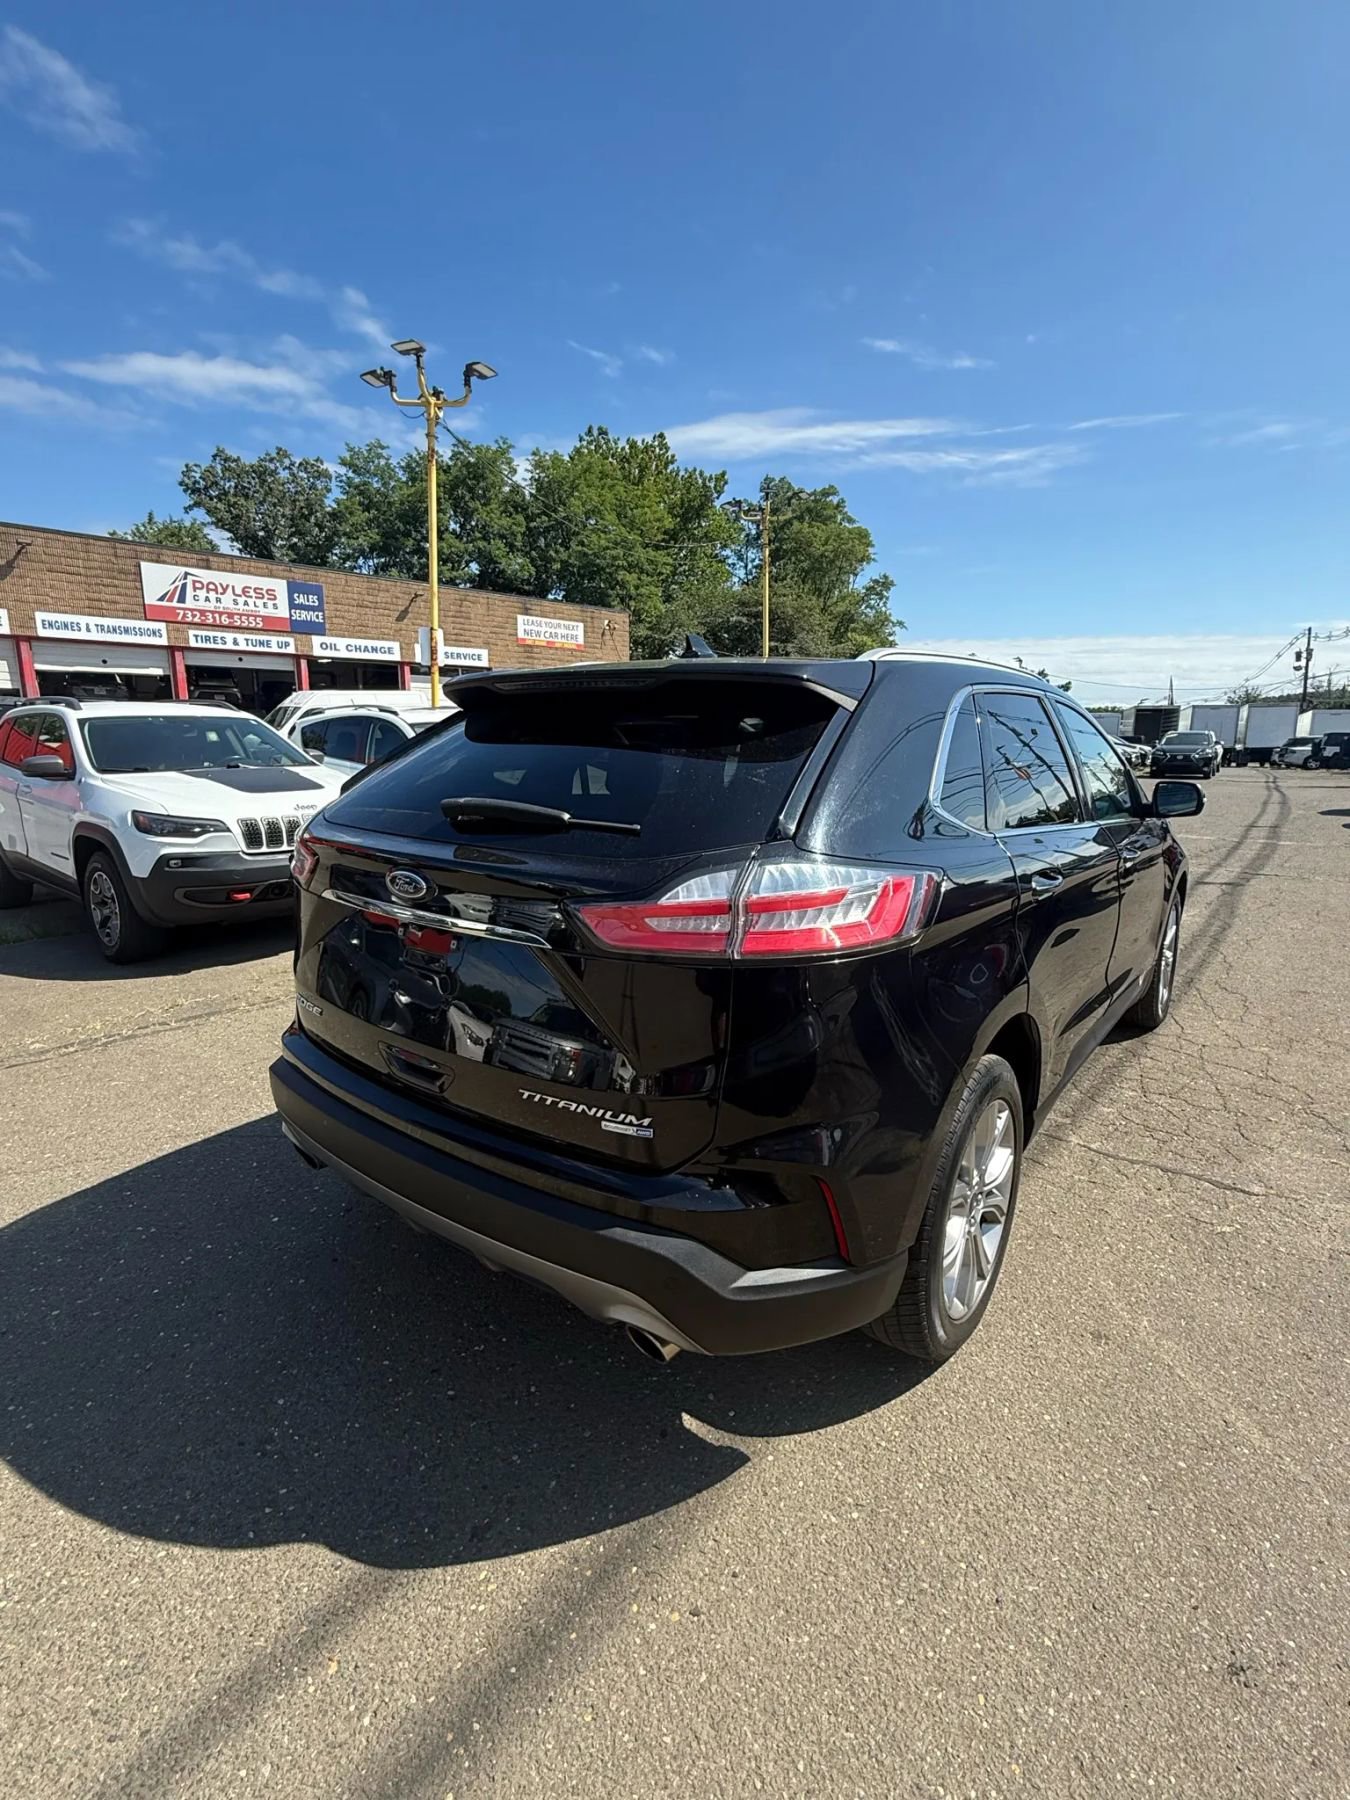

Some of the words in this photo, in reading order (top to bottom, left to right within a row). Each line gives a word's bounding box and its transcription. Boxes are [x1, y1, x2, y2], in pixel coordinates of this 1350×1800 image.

[192, 579, 278, 601] PAYLESS
[192, 594, 223, 604] CAR
[232, 598, 279, 610] SALES
[293, 593, 319, 606] SALES
[176, 609, 264, 628] 732-316-5555
[291, 609, 324, 623] SERVICE
[41, 619, 82, 632] ENGINES
[85, 622, 92, 633] &
[94, 623, 163, 639] TRANSMISSIONS
[522, 618, 543, 628] LEASE
[544, 620, 562, 630] YOUR
[563, 623, 580, 632] NEXT
[192, 634, 227, 645] TIRES
[232, 637, 240, 646] &
[244, 638, 272, 649] TUNE
[276, 640, 290, 650] UP
[523, 628, 542, 638] NEW
[543, 630, 559, 640] CAR
[560, 632, 580, 642] HERE
[319, 641, 341, 652] OIL
[345, 643, 395, 656] CHANGE
[443, 651, 483, 662] SERVICE
[294, 803, 318, 811] Jeep
[394, 875, 416, 893] Ford
[518, 1088, 653, 1127] TITANIUM
